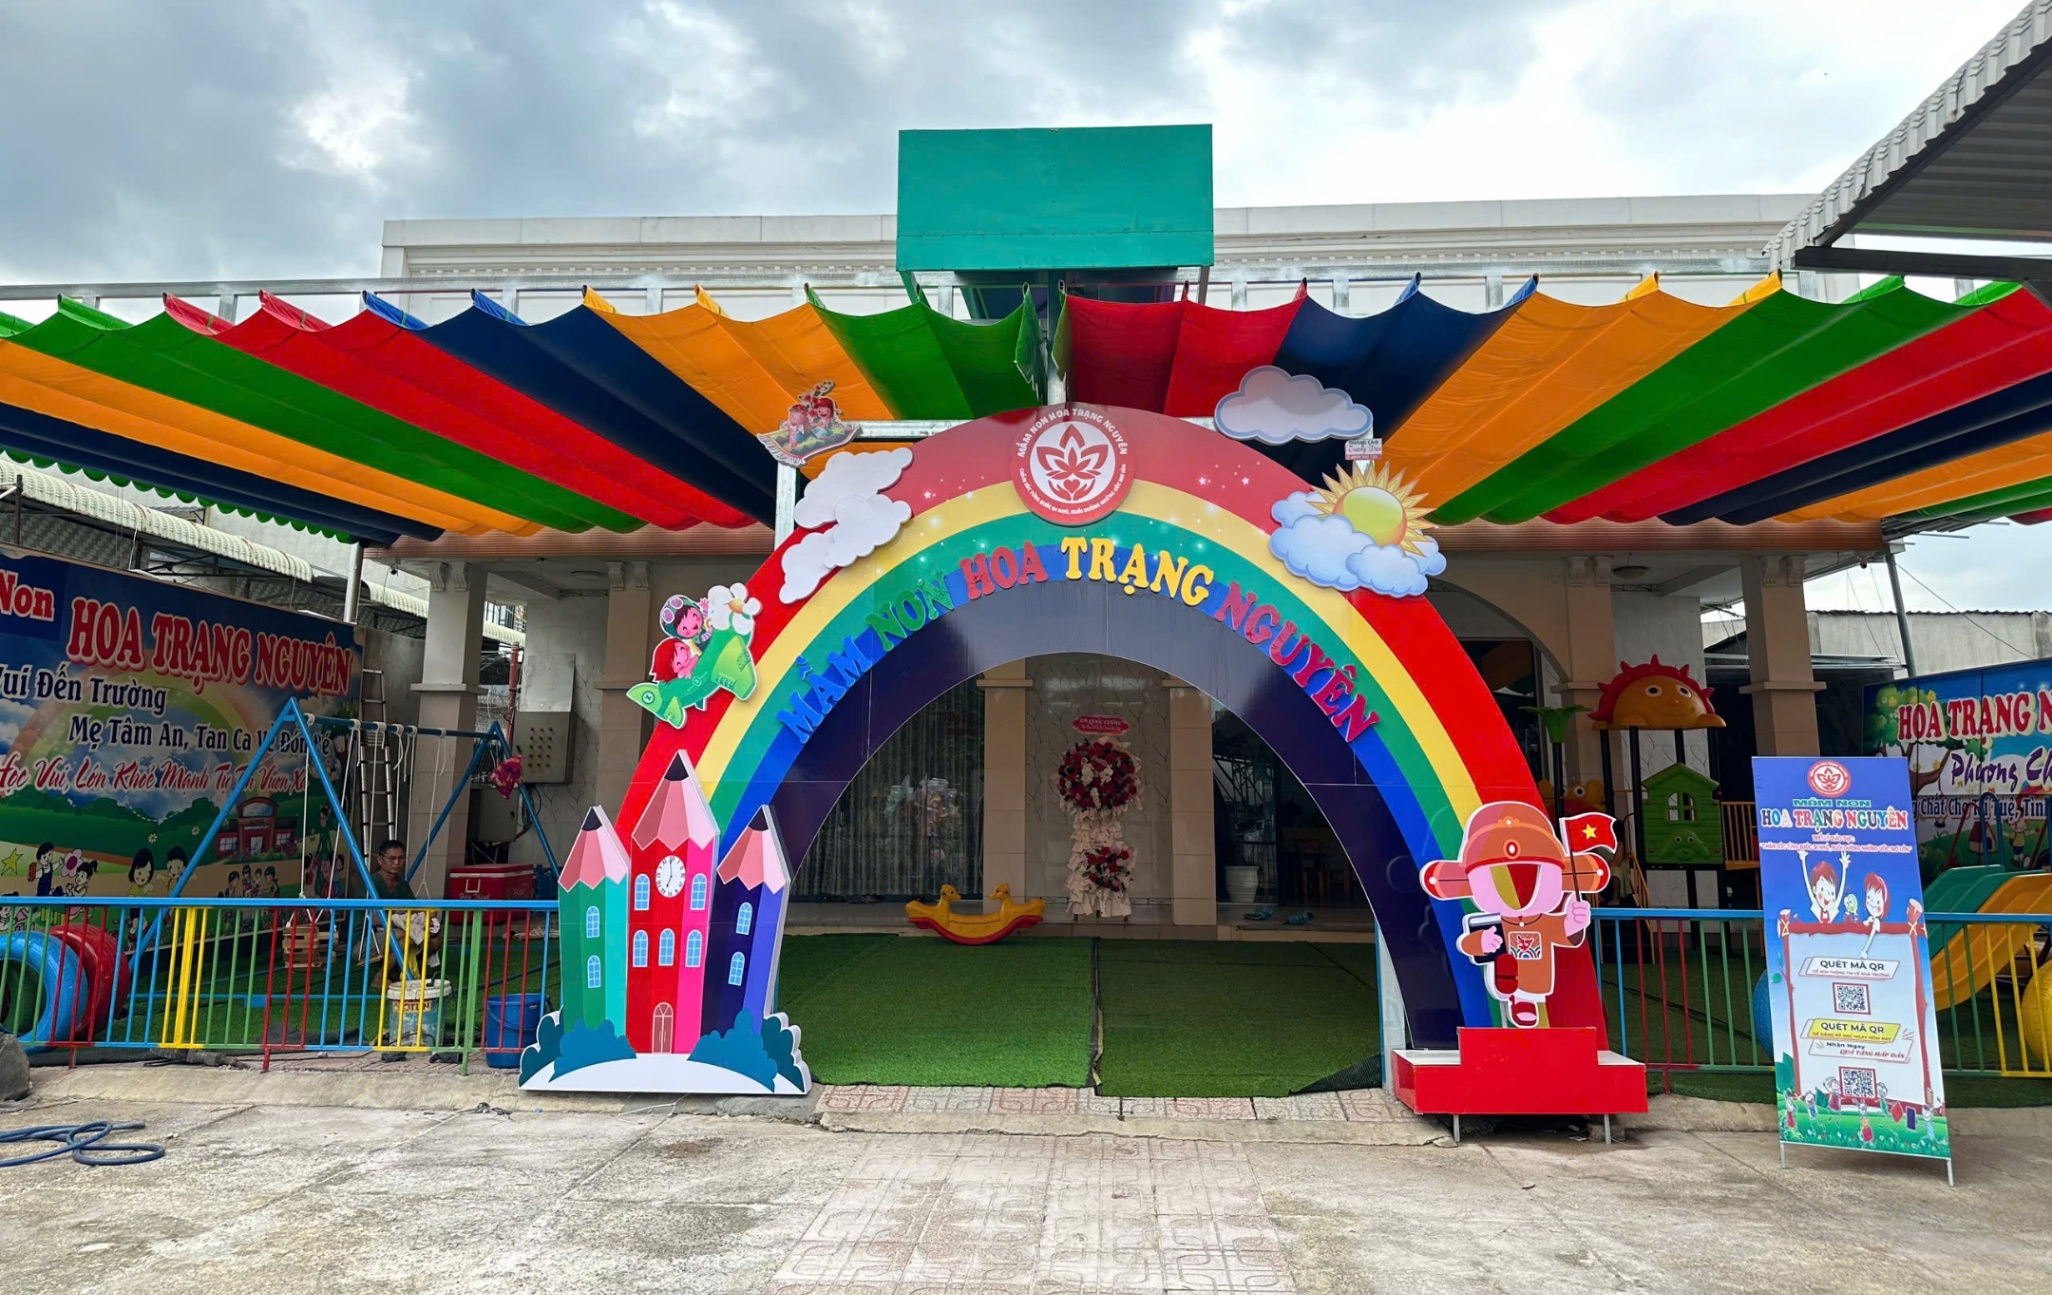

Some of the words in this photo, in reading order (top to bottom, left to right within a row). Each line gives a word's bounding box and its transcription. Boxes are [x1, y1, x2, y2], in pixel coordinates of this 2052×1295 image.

[1030, 416, 1049, 434] NON
[1048, 409, 1070, 421] HOA
[1072, 408, 1104, 423] TRẠNG
[67, 598, 145, 668] HOA
[152, 612, 252, 692] TRẠNG
[255, 632, 353, 696] NGUYÊN
[864, 570, 955, 652] NON
[959, 540, 1049, 600] HOA
[1060, 536, 1214, 606] TRẠNG
[1214, 581, 1381, 742] NGUYÊN
[37, 662, 82, 702] Đến
[90, 676, 167, 716] Trường
[68, 715, 102, 750] Mẹ
[108, 716, 152, 746] Tâm
[159, 723, 189, 751] An,
[196, 725, 227, 750] Tan
[233, 728, 252, 751] Ca
[1897, 702, 1945, 741] HOA
[1947, 691, 2034, 747] TRẠNG
[35, 757, 69, 792] Vui,
[75, 759, 107, 789] Lớn
[160, 760, 209, 795] Mạnh
[1951, 752, 2019, 792] Phương
[1760, 808, 1793, 827] HOA
[1794, 808, 1844, 832] TRẠNG
[1846, 805, 1909, 830] NGUYÊN
[1836, 799, 1872, 808] NON
[1820, 959, 1847, 968] QUÉT
[1850, 960, 1867, 970] MÃ
[1869, 962, 1884, 971] QR
[1820, 1021, 1848, 1031] QUÉT
[1851, 1022, 1867, 1032] MÃ
[1869, 1025, 1884, 1034] QR
